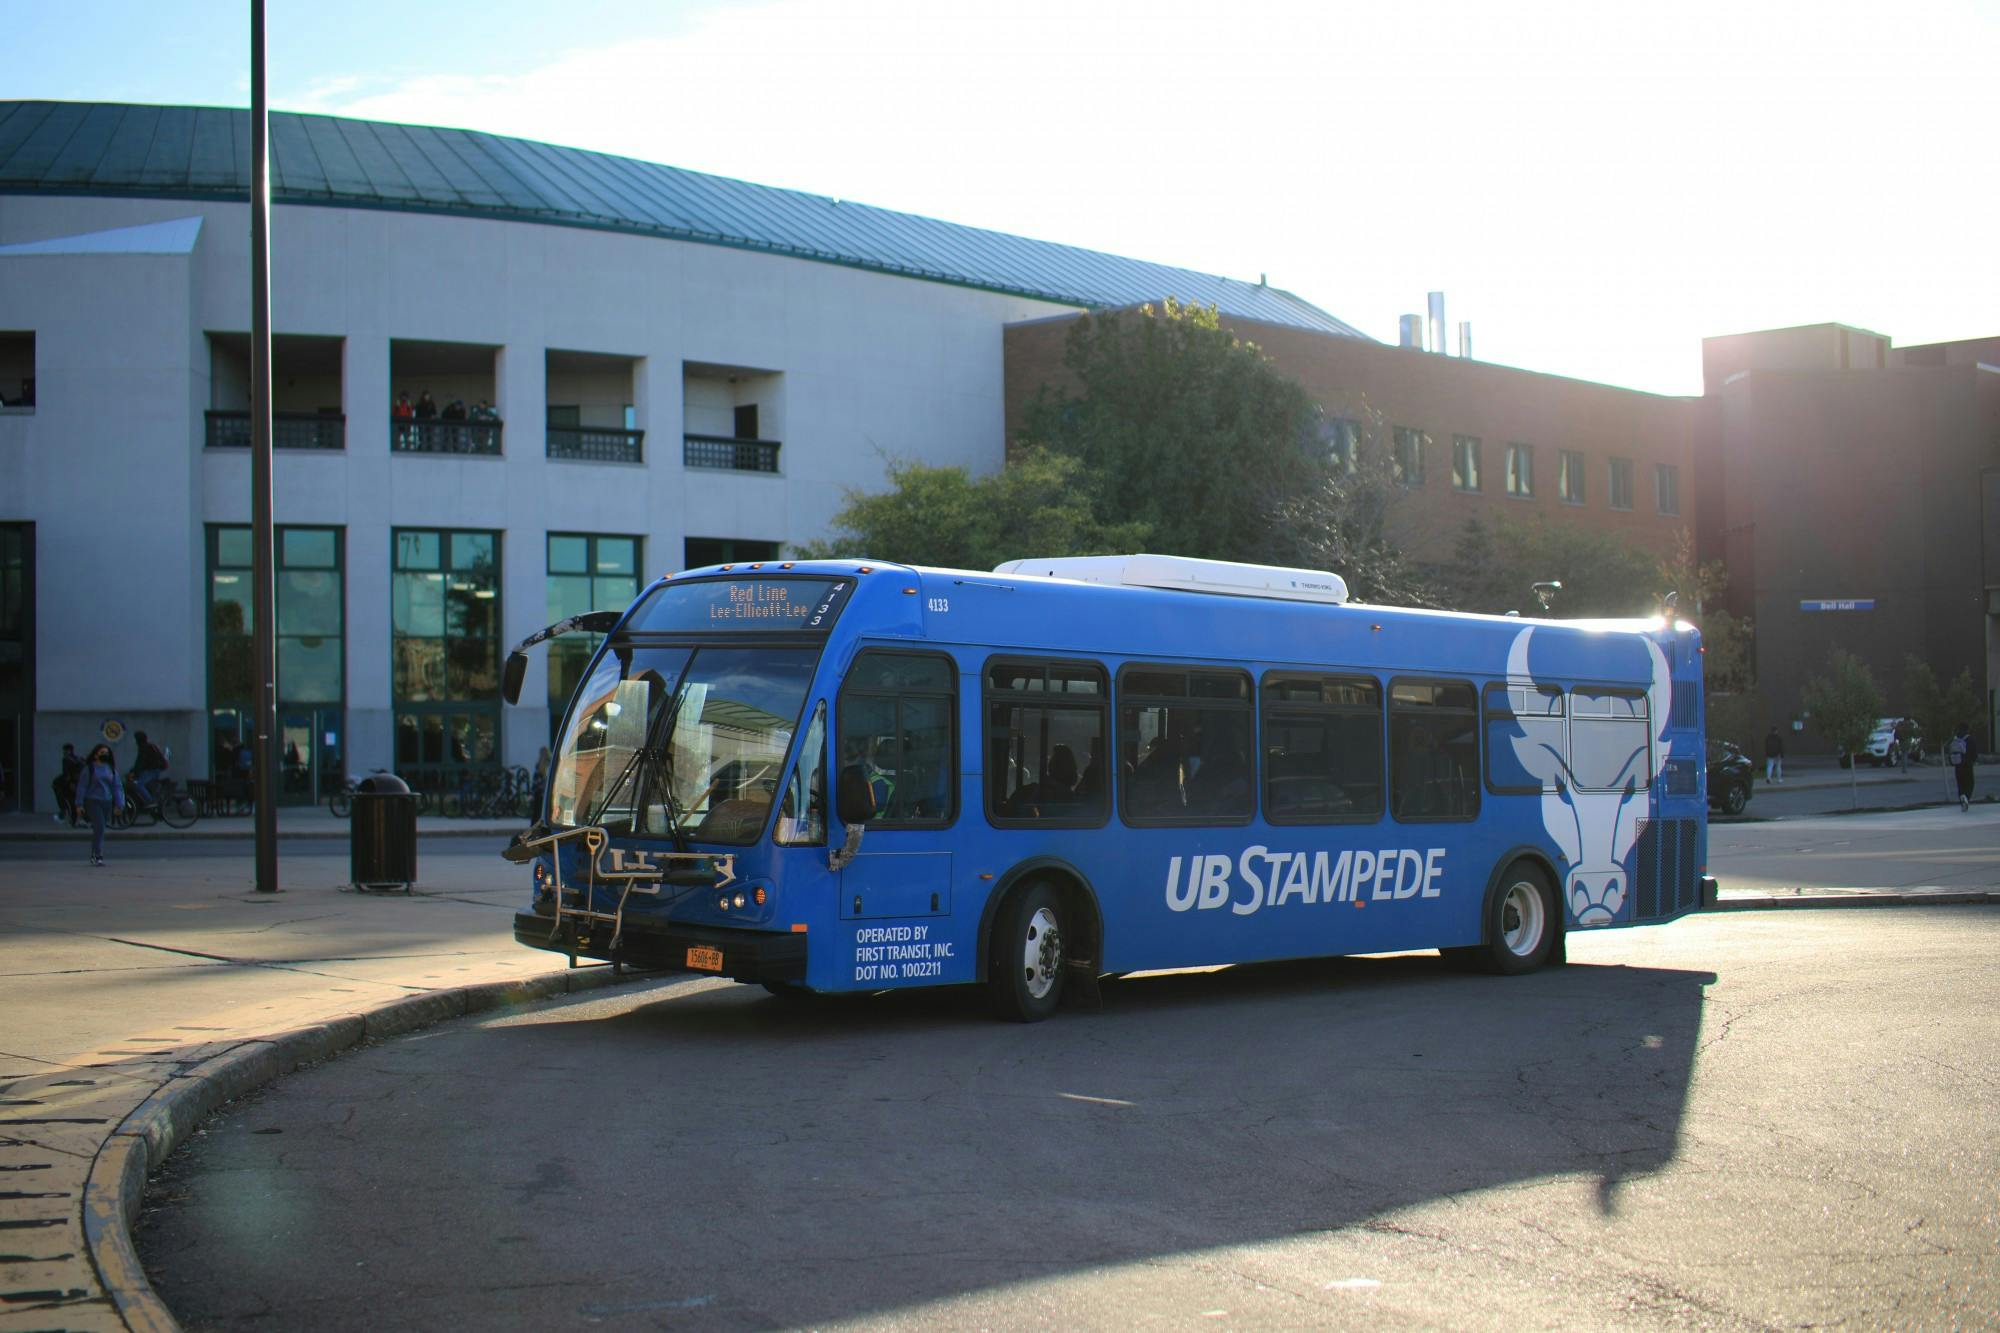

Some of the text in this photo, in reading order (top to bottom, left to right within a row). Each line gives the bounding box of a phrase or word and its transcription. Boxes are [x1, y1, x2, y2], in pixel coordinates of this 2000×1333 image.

[730, 584, 788, 602] Red Line
[710, 602, 808, 619] Lee-Ellicott-Lee
[927, 598, 949, 612] 4133
[1838, 601, 1855, 610] Hall
[1166, 845, 1446, 914] UB STAMPEDE
[856, 926, 928, 943] OPERATED BY
[856, 943, 954, 962] FIRST TRANSIT, INC.
[856, 961, 941, 980] DOT NO. 1002211
